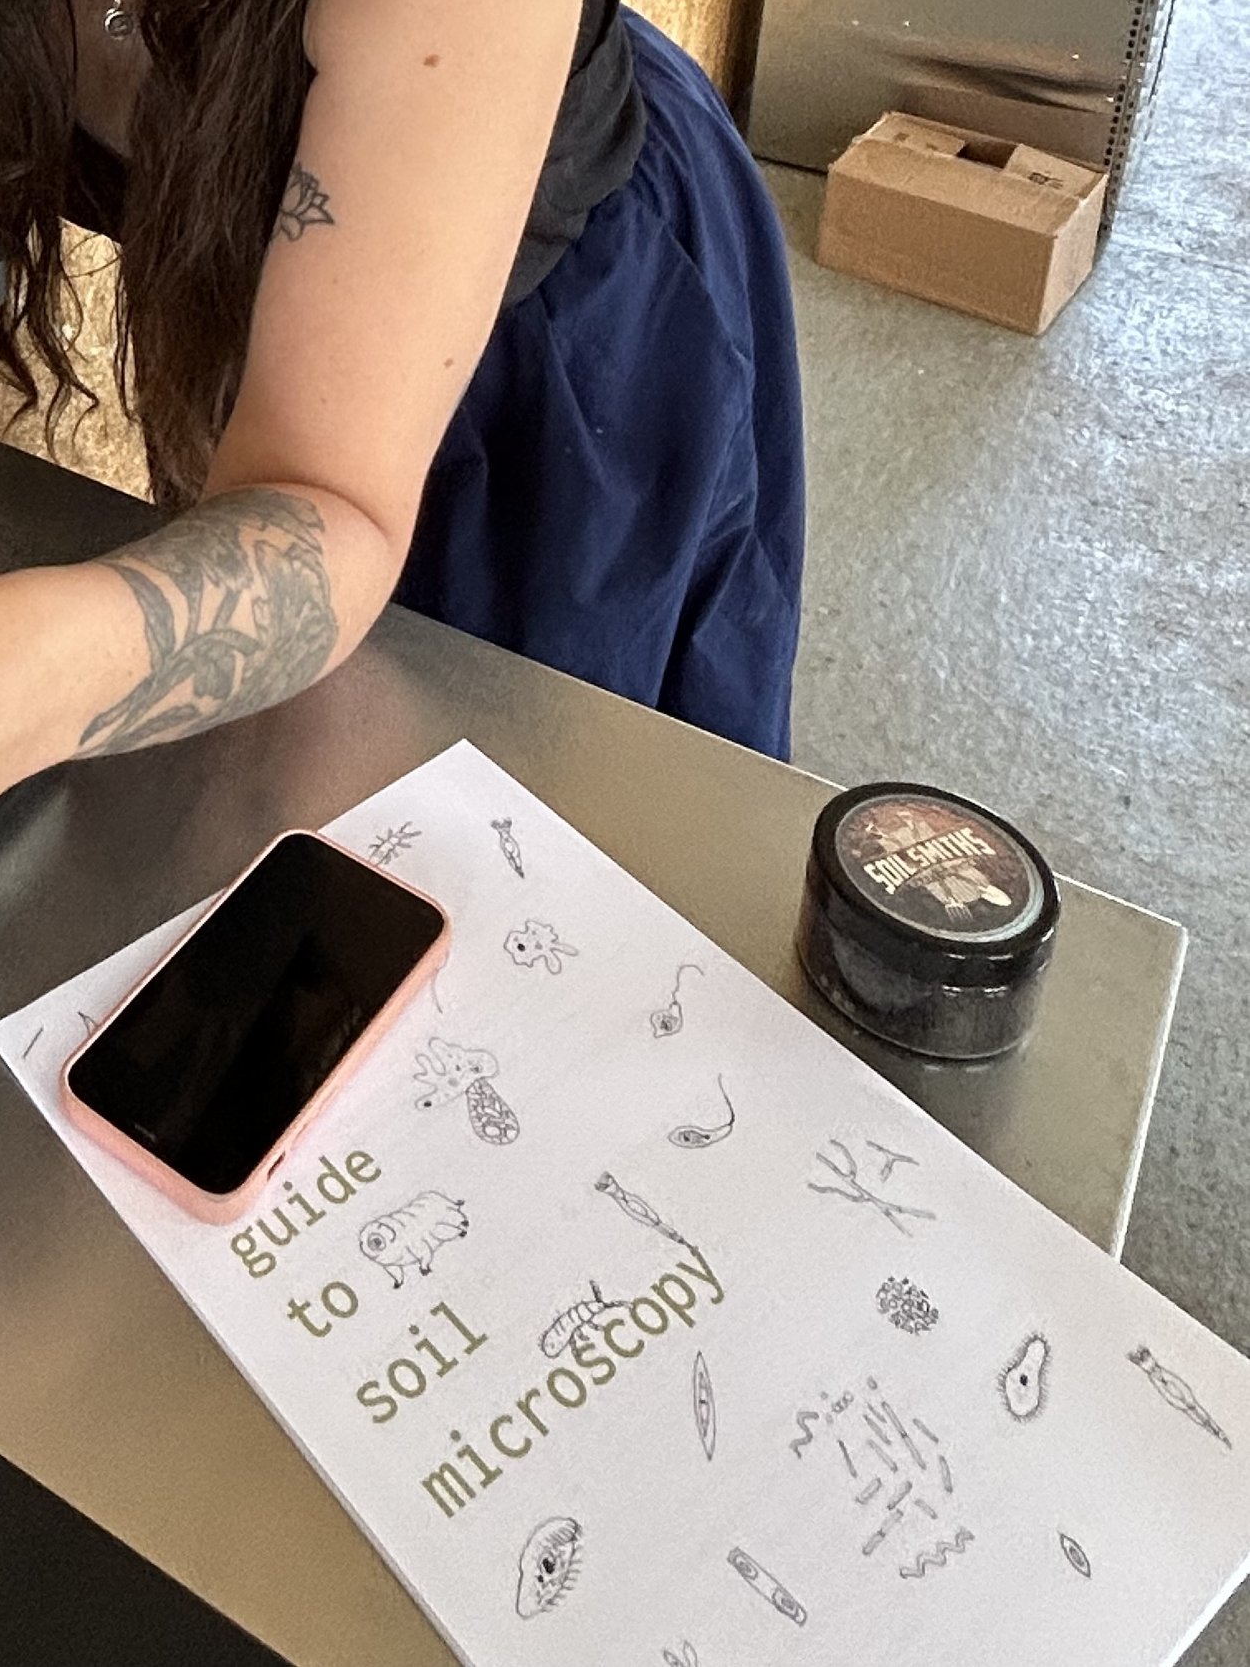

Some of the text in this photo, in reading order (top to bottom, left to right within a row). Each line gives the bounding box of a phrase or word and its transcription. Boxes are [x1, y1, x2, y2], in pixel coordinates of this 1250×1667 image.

[863, 854, 917, 895] SOIL
[906, 827, 997, 869] SMITHS
[230, 1148, 382, 1279] guide
[286, 1280, 359, 1338] to
[355, 1302, 489, 1425] soil
[420, 1247, 726, 1518] microscopy
